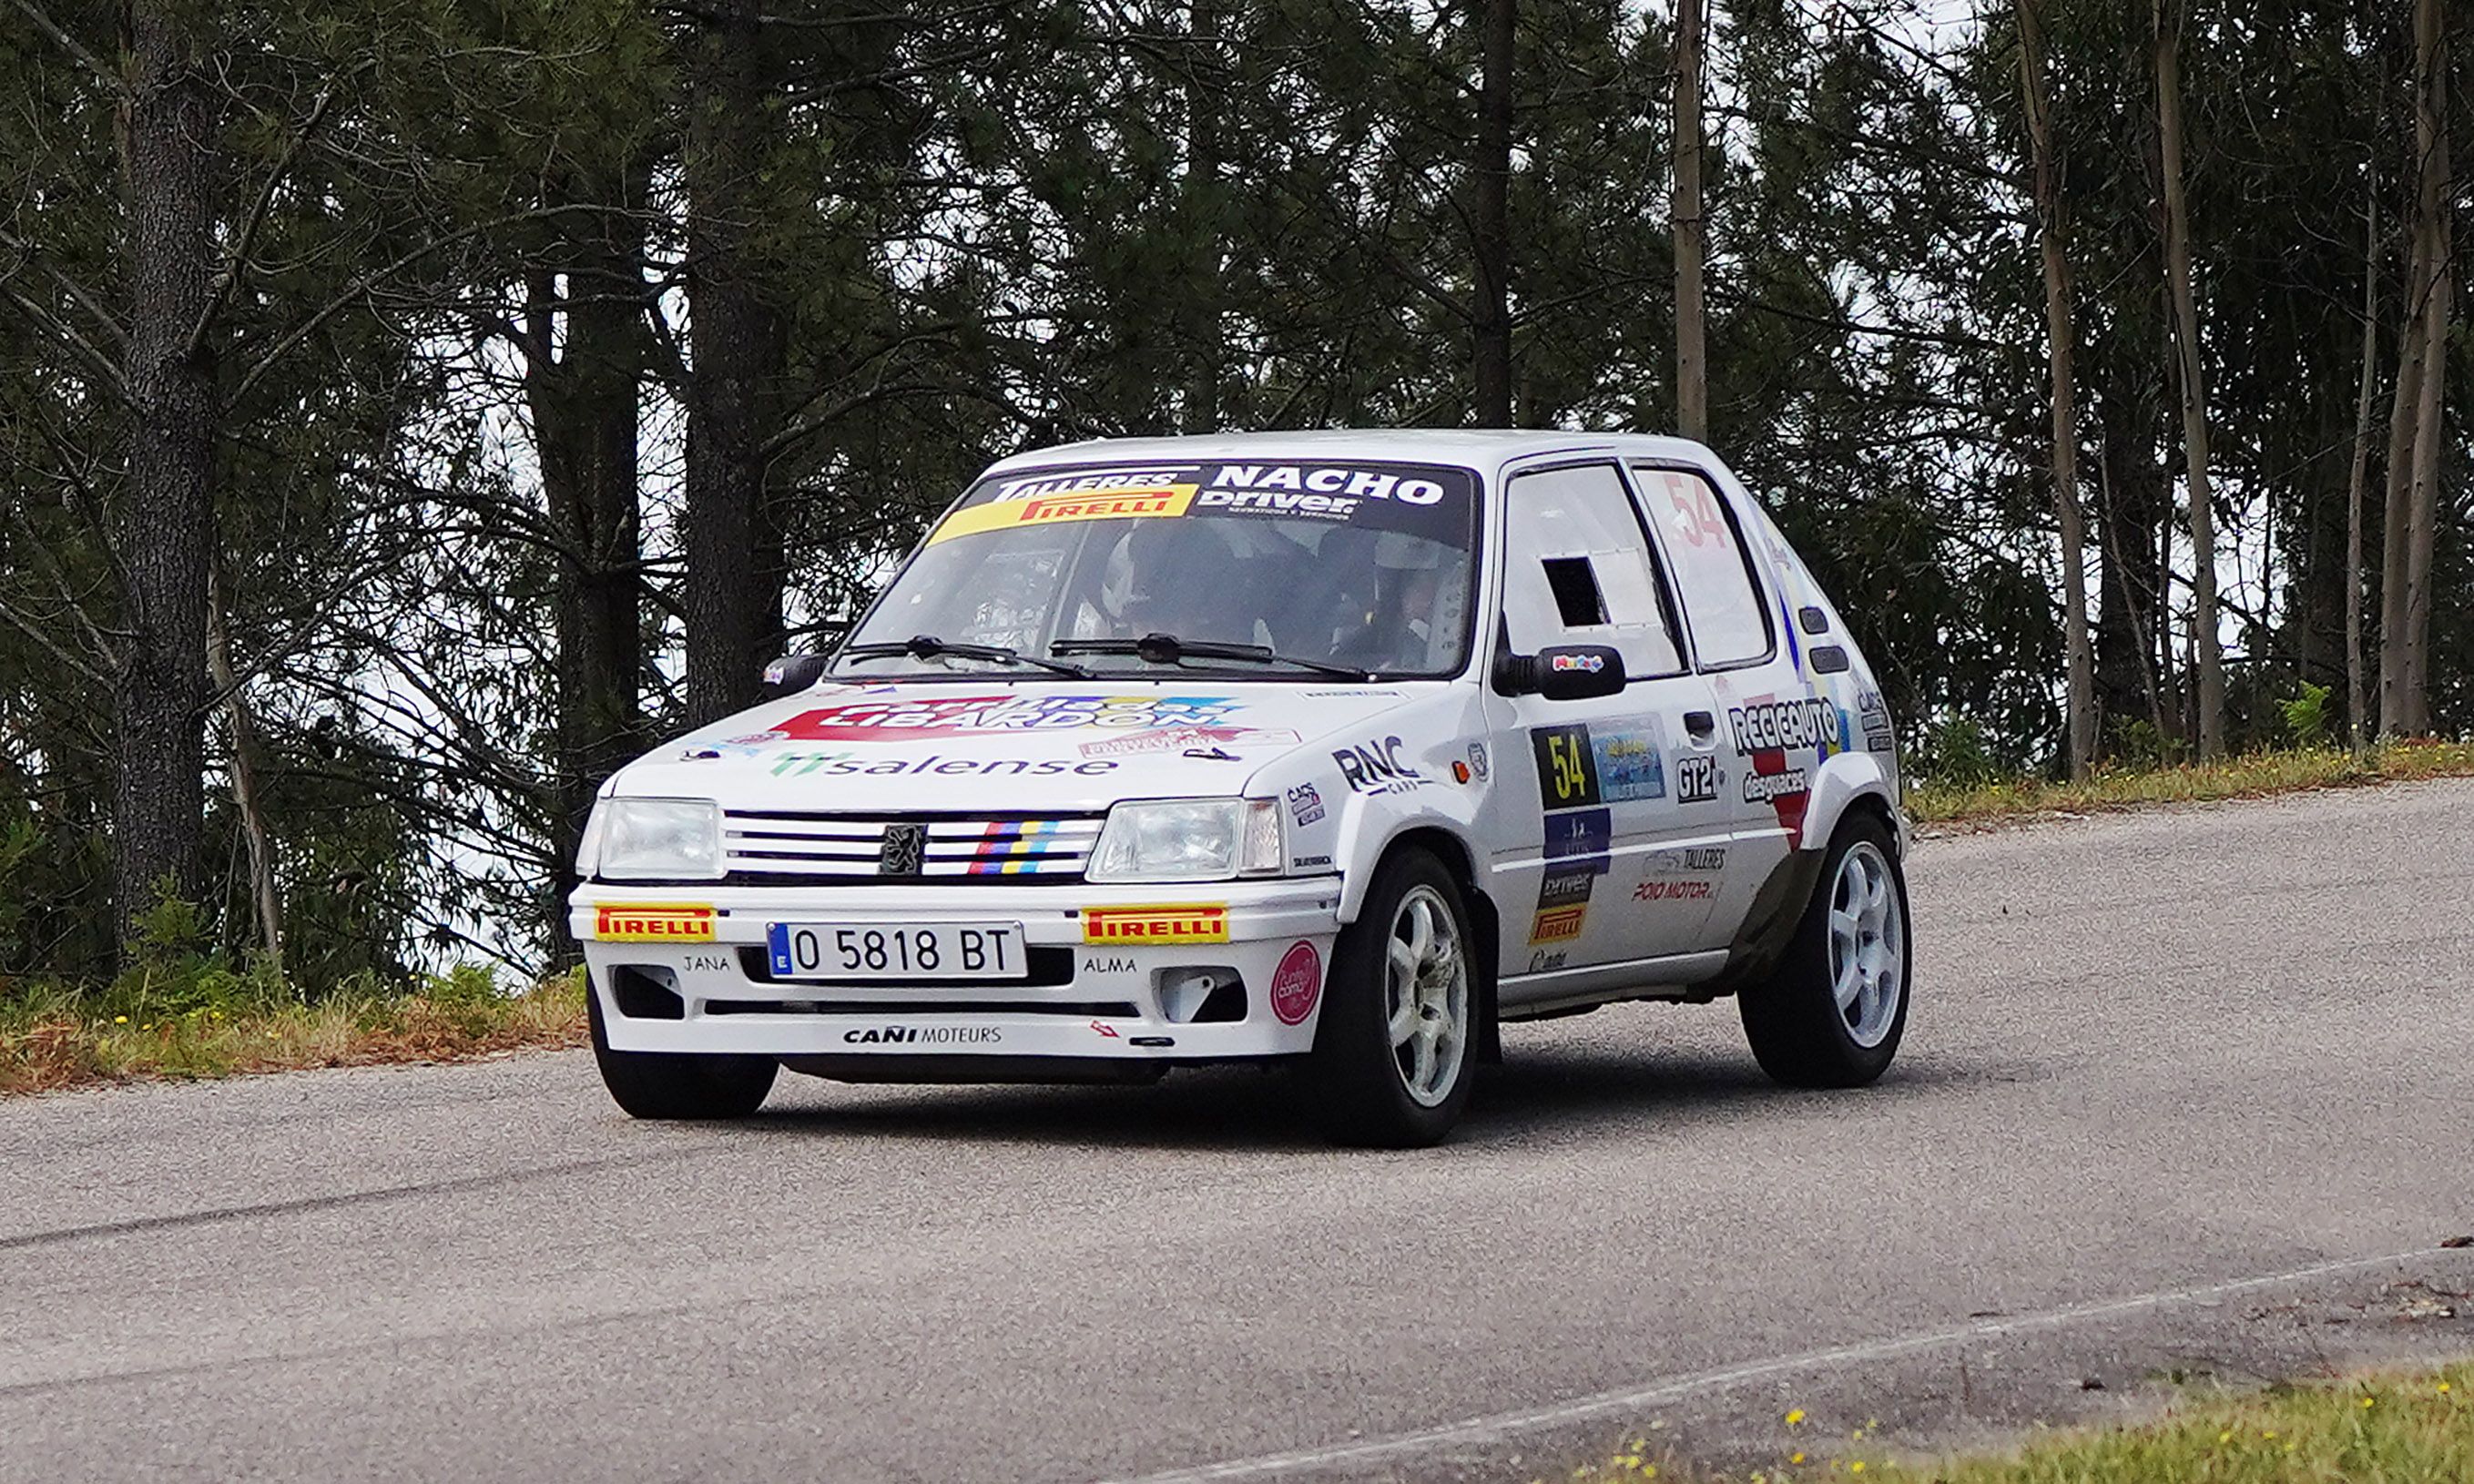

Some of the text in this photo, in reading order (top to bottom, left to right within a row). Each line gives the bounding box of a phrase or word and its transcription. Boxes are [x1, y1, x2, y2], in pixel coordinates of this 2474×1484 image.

[993, 465, 1201, 503] TALLERES
[1212, 465, 1444, 505] NACHO
[1019, 492, 1175, 521] PIRELLI
[1662, 474, 1727, 548] 54
[1331, 736, 1420, 792] RNC
[1548, 734, 1586, 799] 54
[598, 908, 712, 935] PIRELLI
[1088, 907, 1225, 937] PIRELLI
[1534, 909, 1583, 940] PIRELLI
[684, 956, 730, 971] JANA
[776, 955, 789, 968] E
[836, 930, 941, 971] 5818
[959, 929, 1010, 971] BT
[1084, 958, 1138, 972] ALMA
[921, 1027, 1003, 1043] MOTEURS
